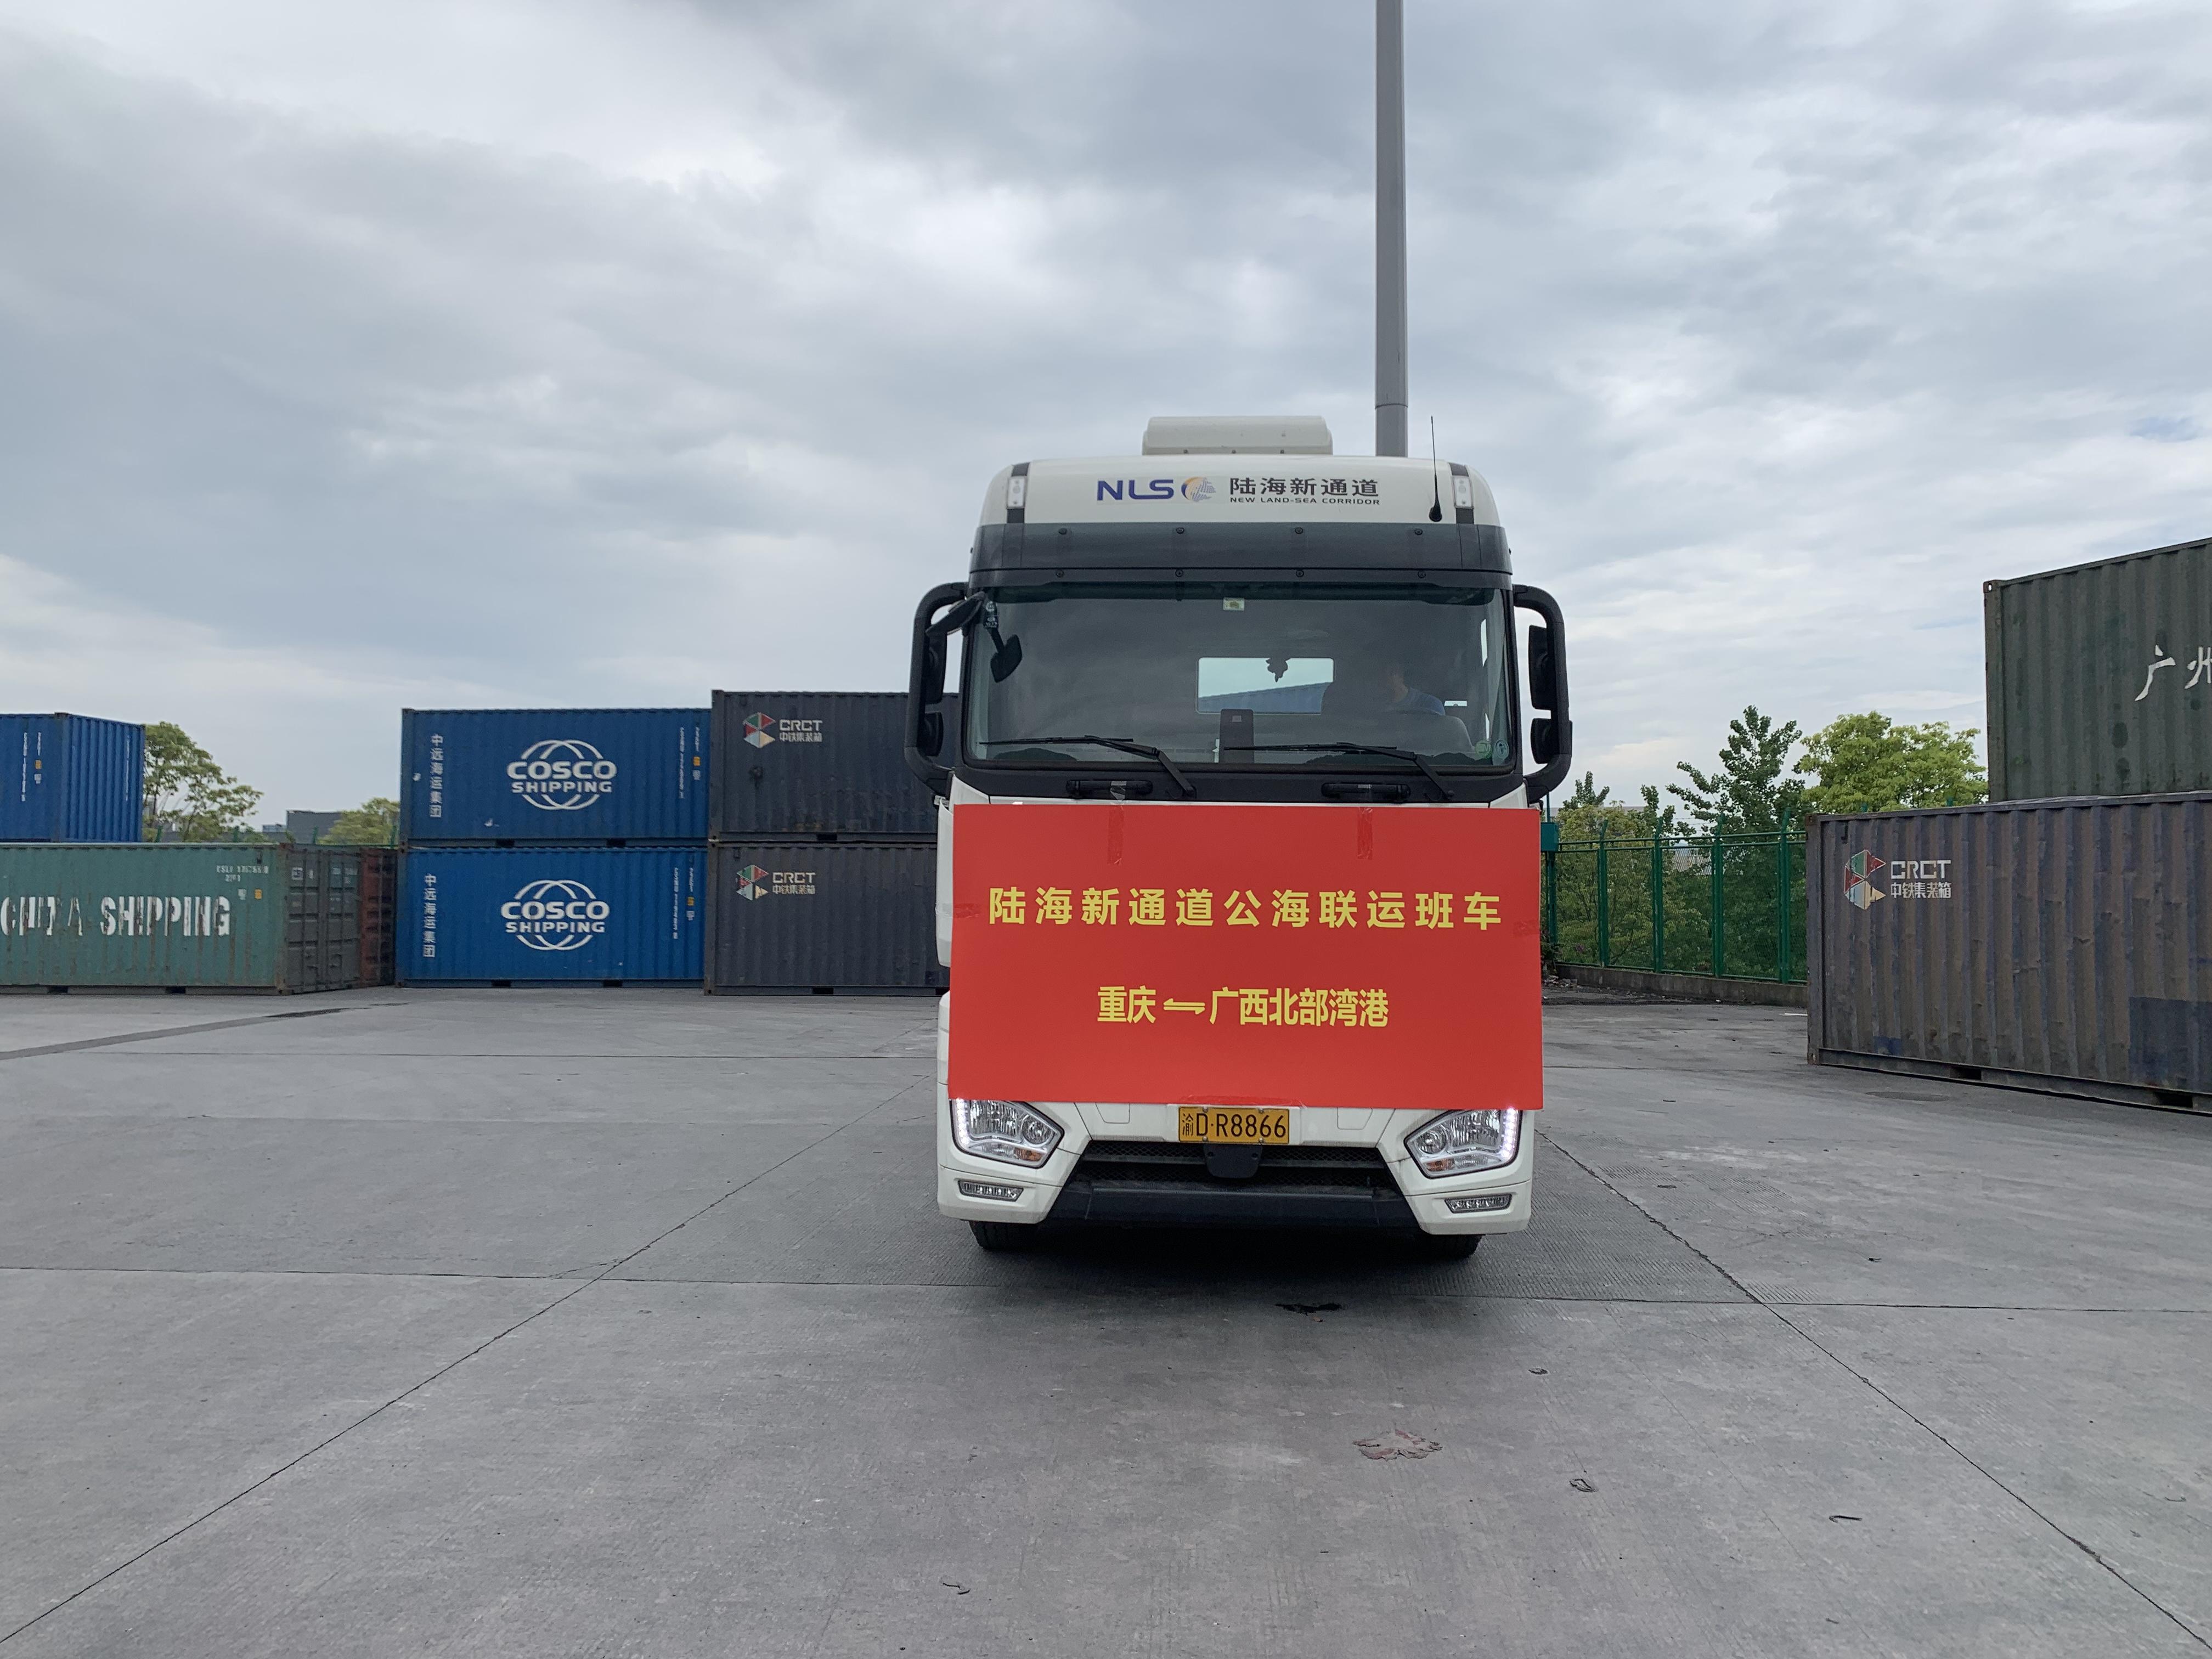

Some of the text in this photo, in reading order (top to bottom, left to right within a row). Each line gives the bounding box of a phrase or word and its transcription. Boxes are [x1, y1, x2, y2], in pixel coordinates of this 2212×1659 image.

[1097, 479, 1174, 501] NLS
[1229, 477, 1379, 496] 陆海新通道
[779, 719, 823, 732] CRCT
[779, 732, 822, 743] 中铁集装箱
[506, 760, 618, 780] COSCO
[511, 781, 613, 793] SHIPPING
[772, 872, 816, 883] CRCT
[1891, 860, 1952, 879] CRCT
[772, 884, 816, 895] 中铁集装箱
[1891, 882, 1952, 899] 中铁集装箱
[100, 896, 230, 936] SHIPPING
[500, 901, 610, 919] COSCO
[988, 886, 1503, 930] 陆海新通道公海联运班车
[505, 922, 605, 933] SHIPPING
[1097, 985, 1390, 1028] 重庆 广西北部湾港
